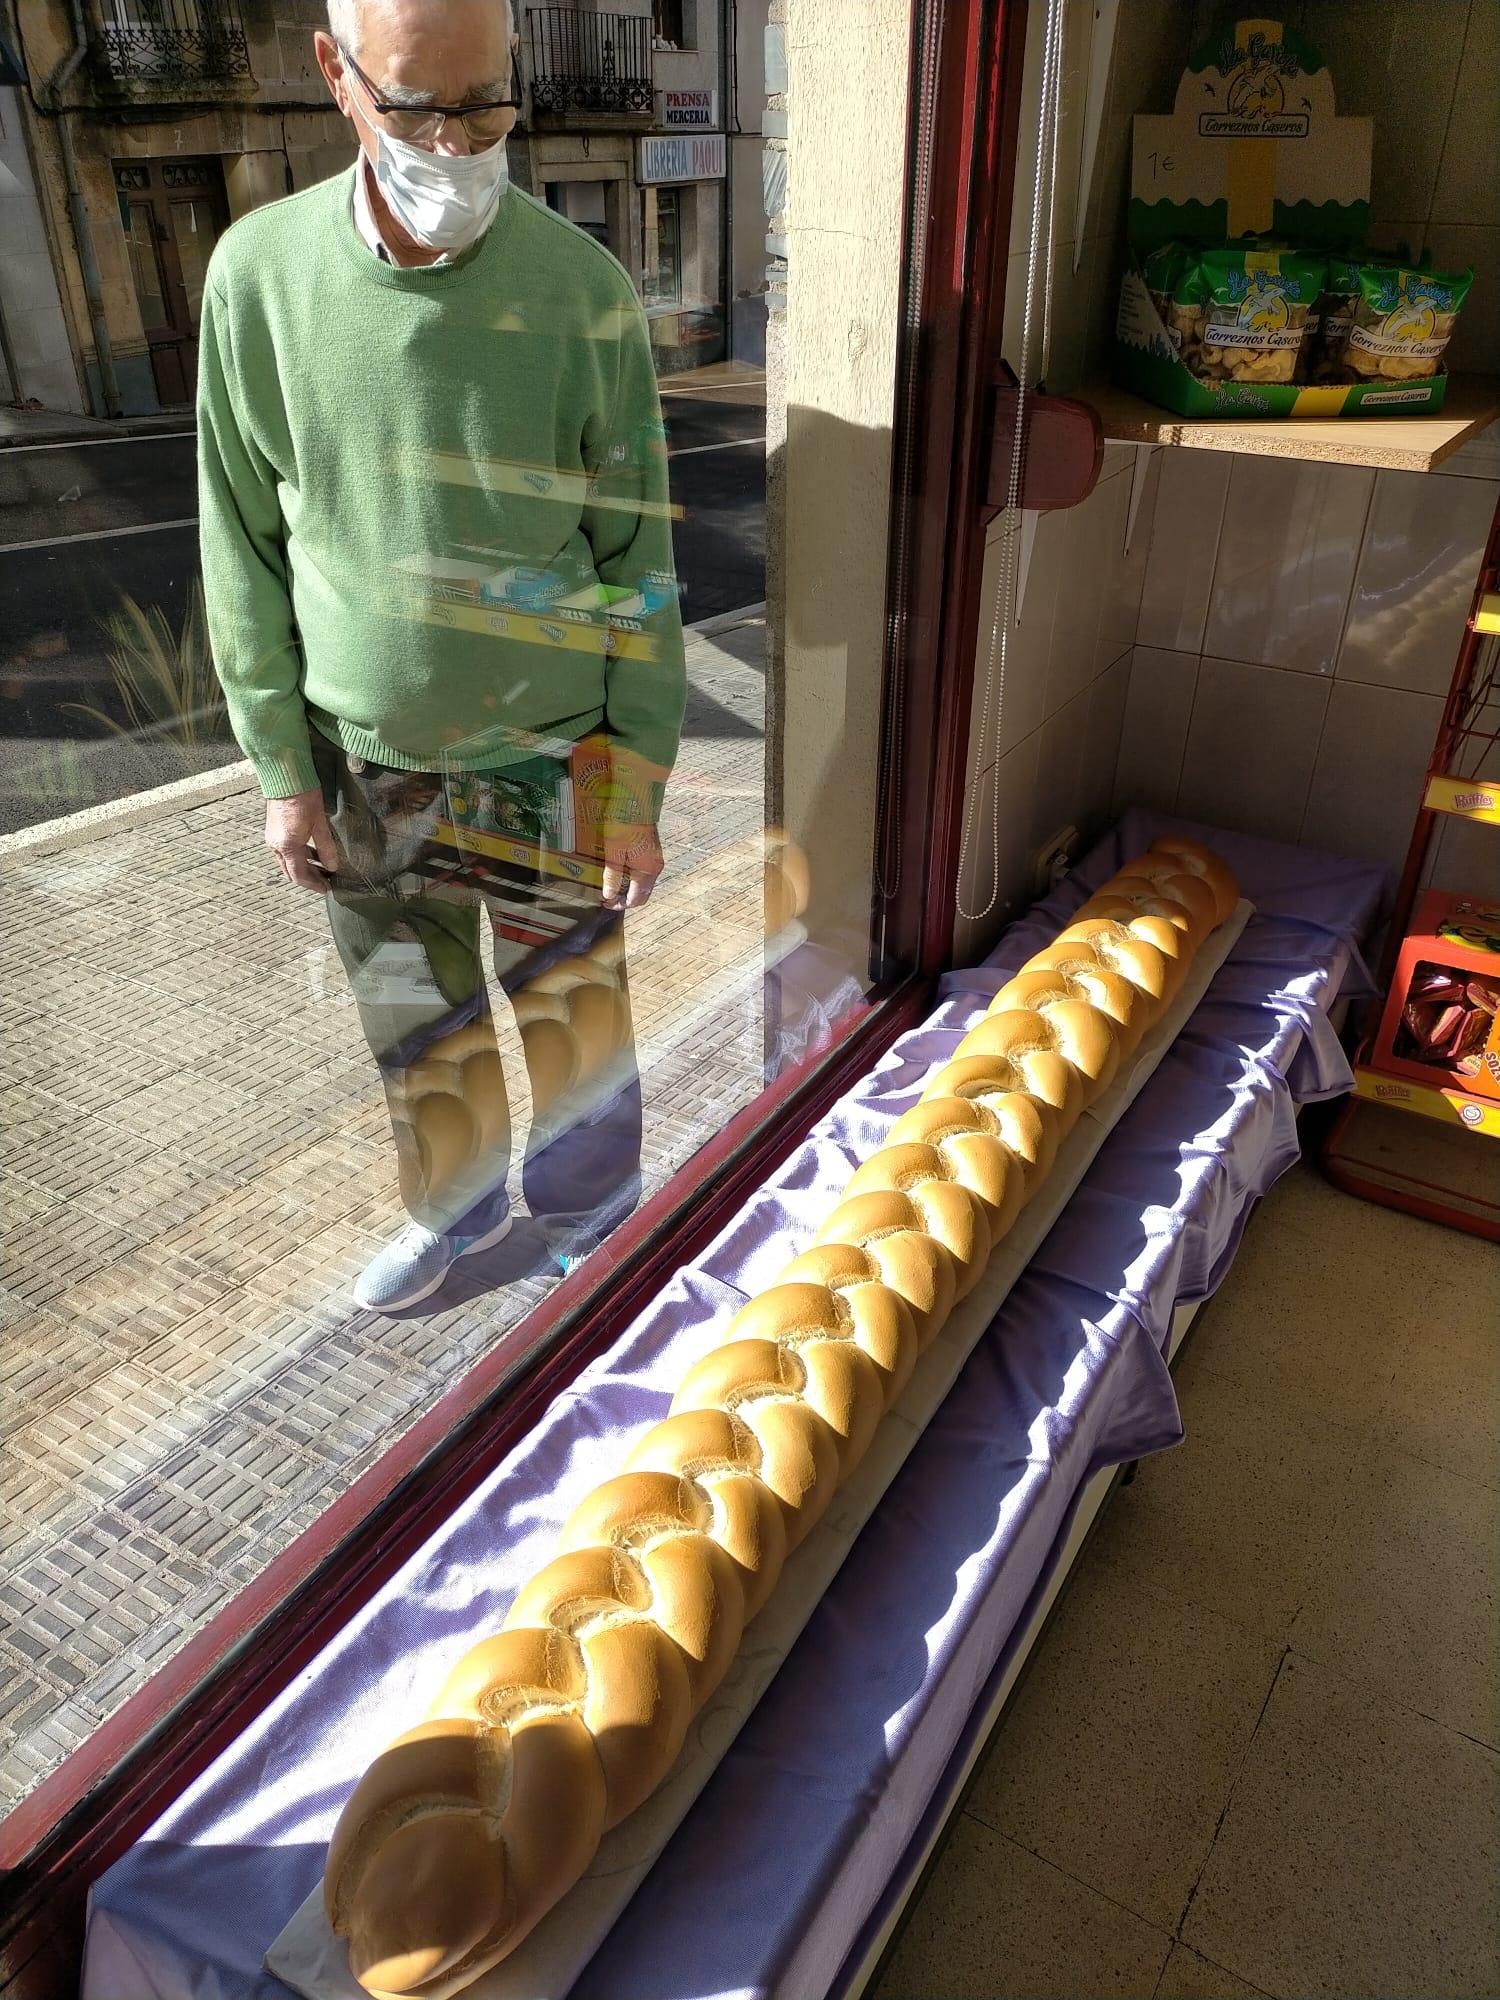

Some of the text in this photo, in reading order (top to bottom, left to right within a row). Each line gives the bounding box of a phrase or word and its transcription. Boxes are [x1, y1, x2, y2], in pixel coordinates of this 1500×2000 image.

[665, 93, 710, 107] PRENSA
[665, 109, 710, 124] MERCERIA
[1204, 118, 1304, 133] Torreznos Caseros
[645, 139, 723, 179] LIBRERIA PAQUI
[1147, 152, 1175, 180] 1€
[1205, 328, 1265, 346] Torreznos
[1351, 329, 1409, 354] Torreznos
[1454, 793, 1493, 809] Ruffles
